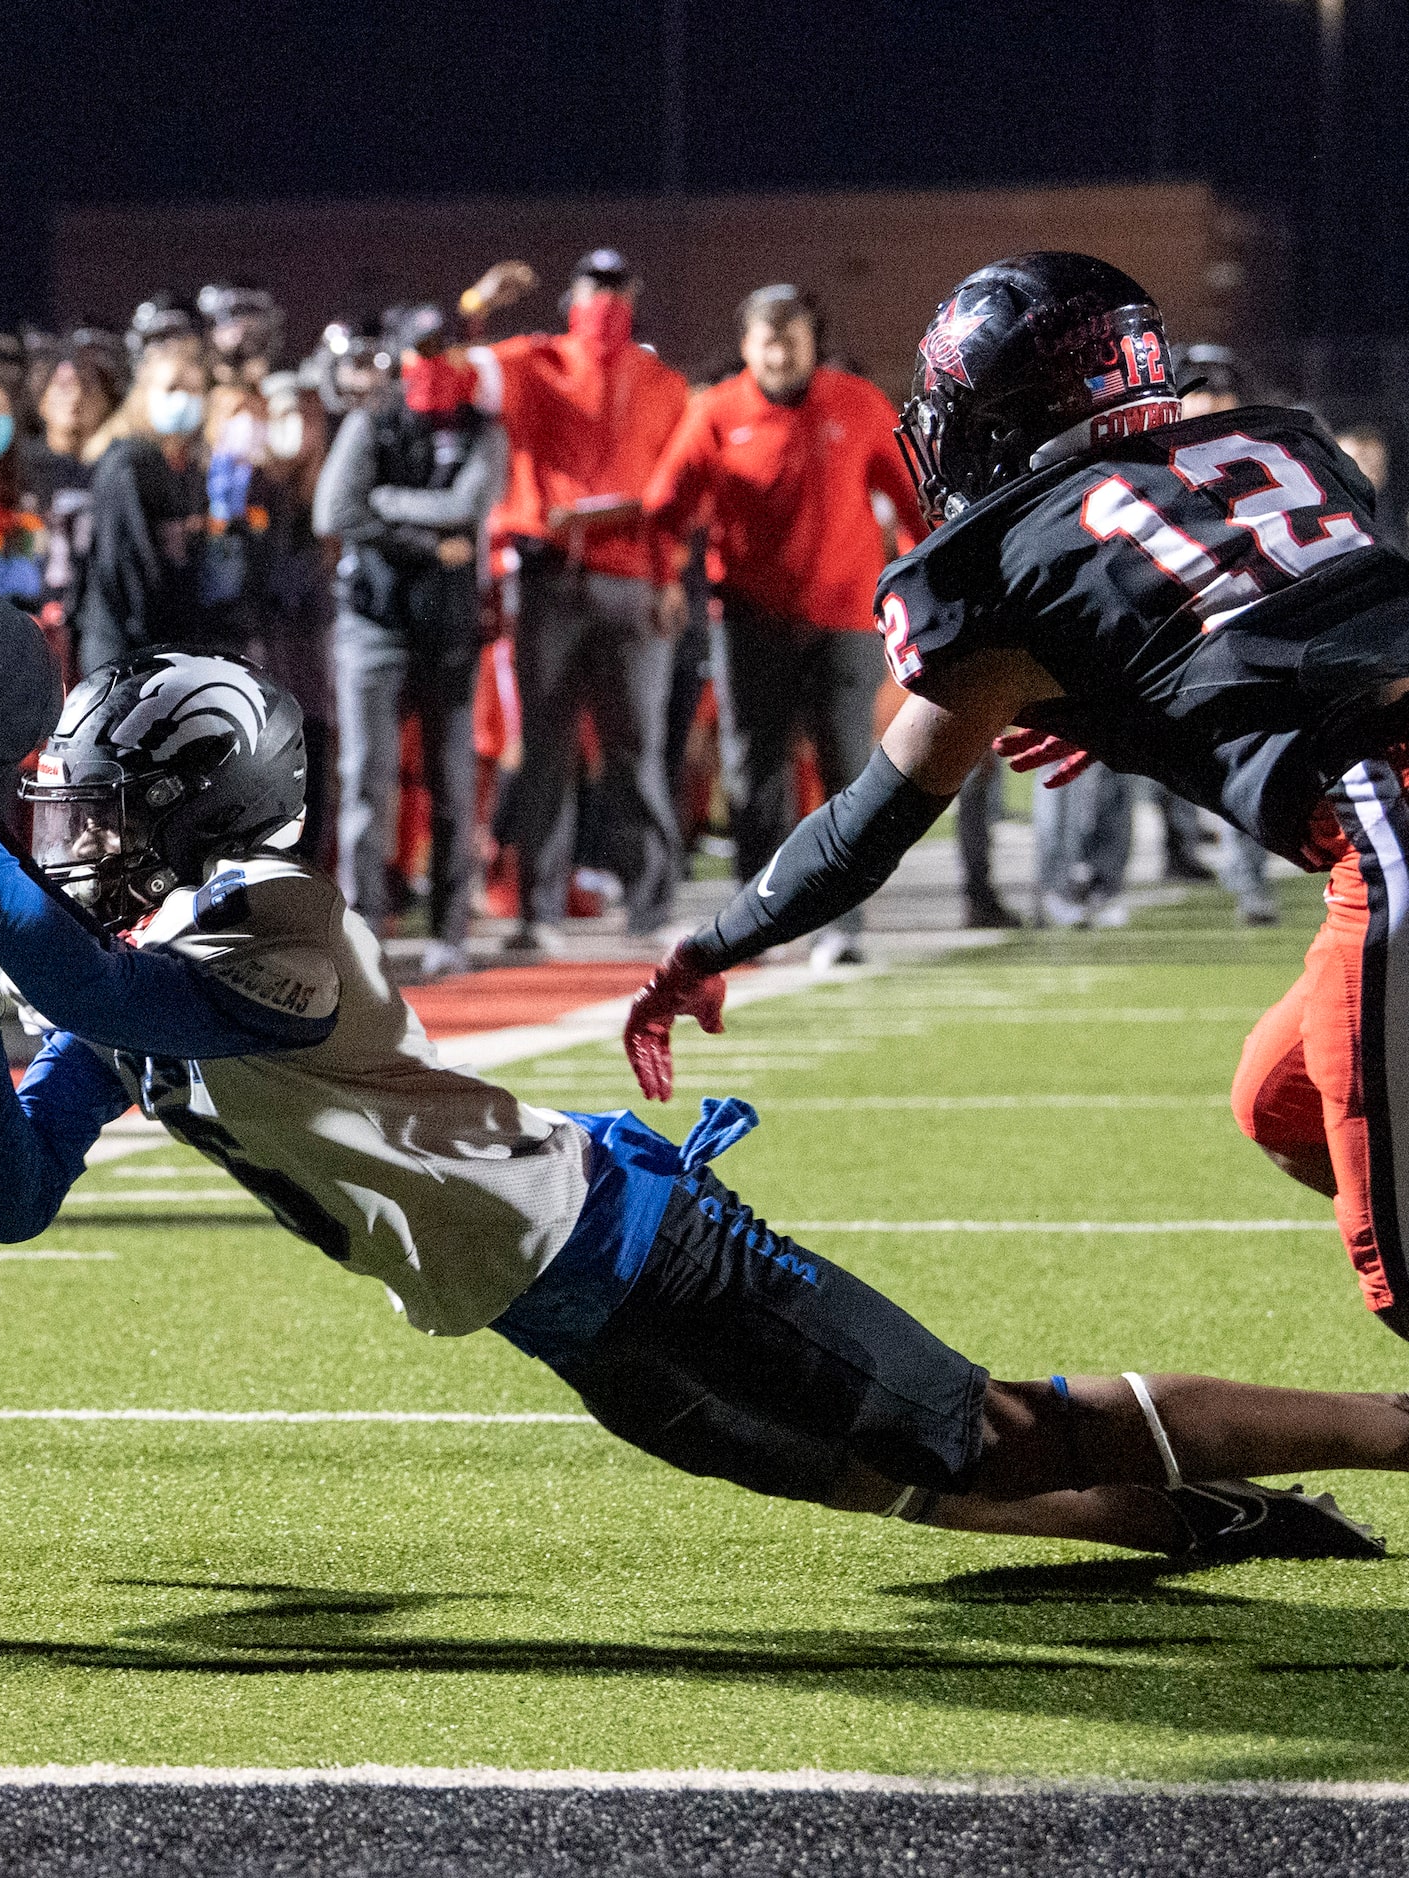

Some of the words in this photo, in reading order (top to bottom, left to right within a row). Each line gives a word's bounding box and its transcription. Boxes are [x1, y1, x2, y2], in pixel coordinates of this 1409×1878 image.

[1120, 331, 1165, 387] 12
[1079, 431, 1374, 634] 12
[874, 591, 923, 688] 2
